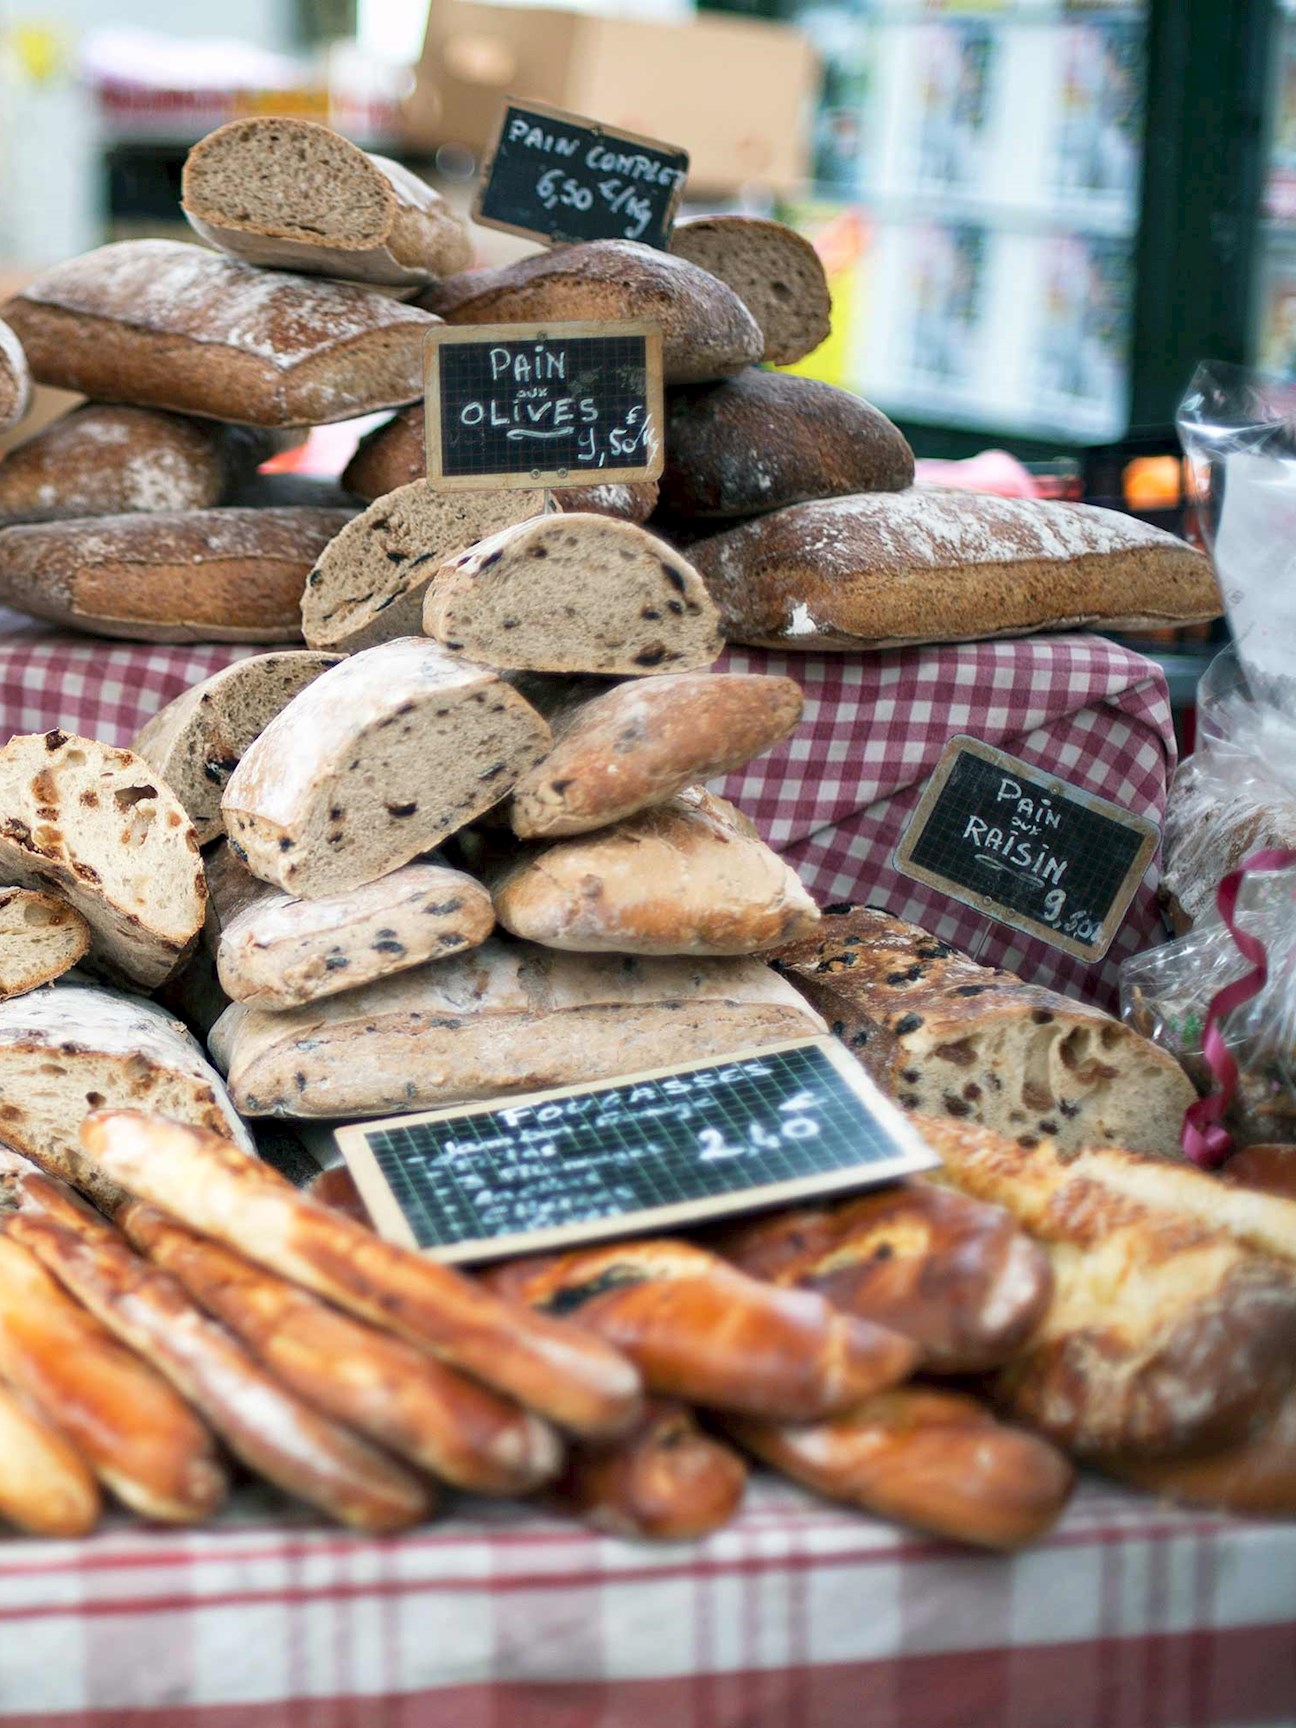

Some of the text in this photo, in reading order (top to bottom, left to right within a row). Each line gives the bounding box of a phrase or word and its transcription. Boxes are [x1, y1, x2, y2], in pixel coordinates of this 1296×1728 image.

[508, 119, 687, 192] PAIN COMPLET
[516, 386, 549, 399] aux
